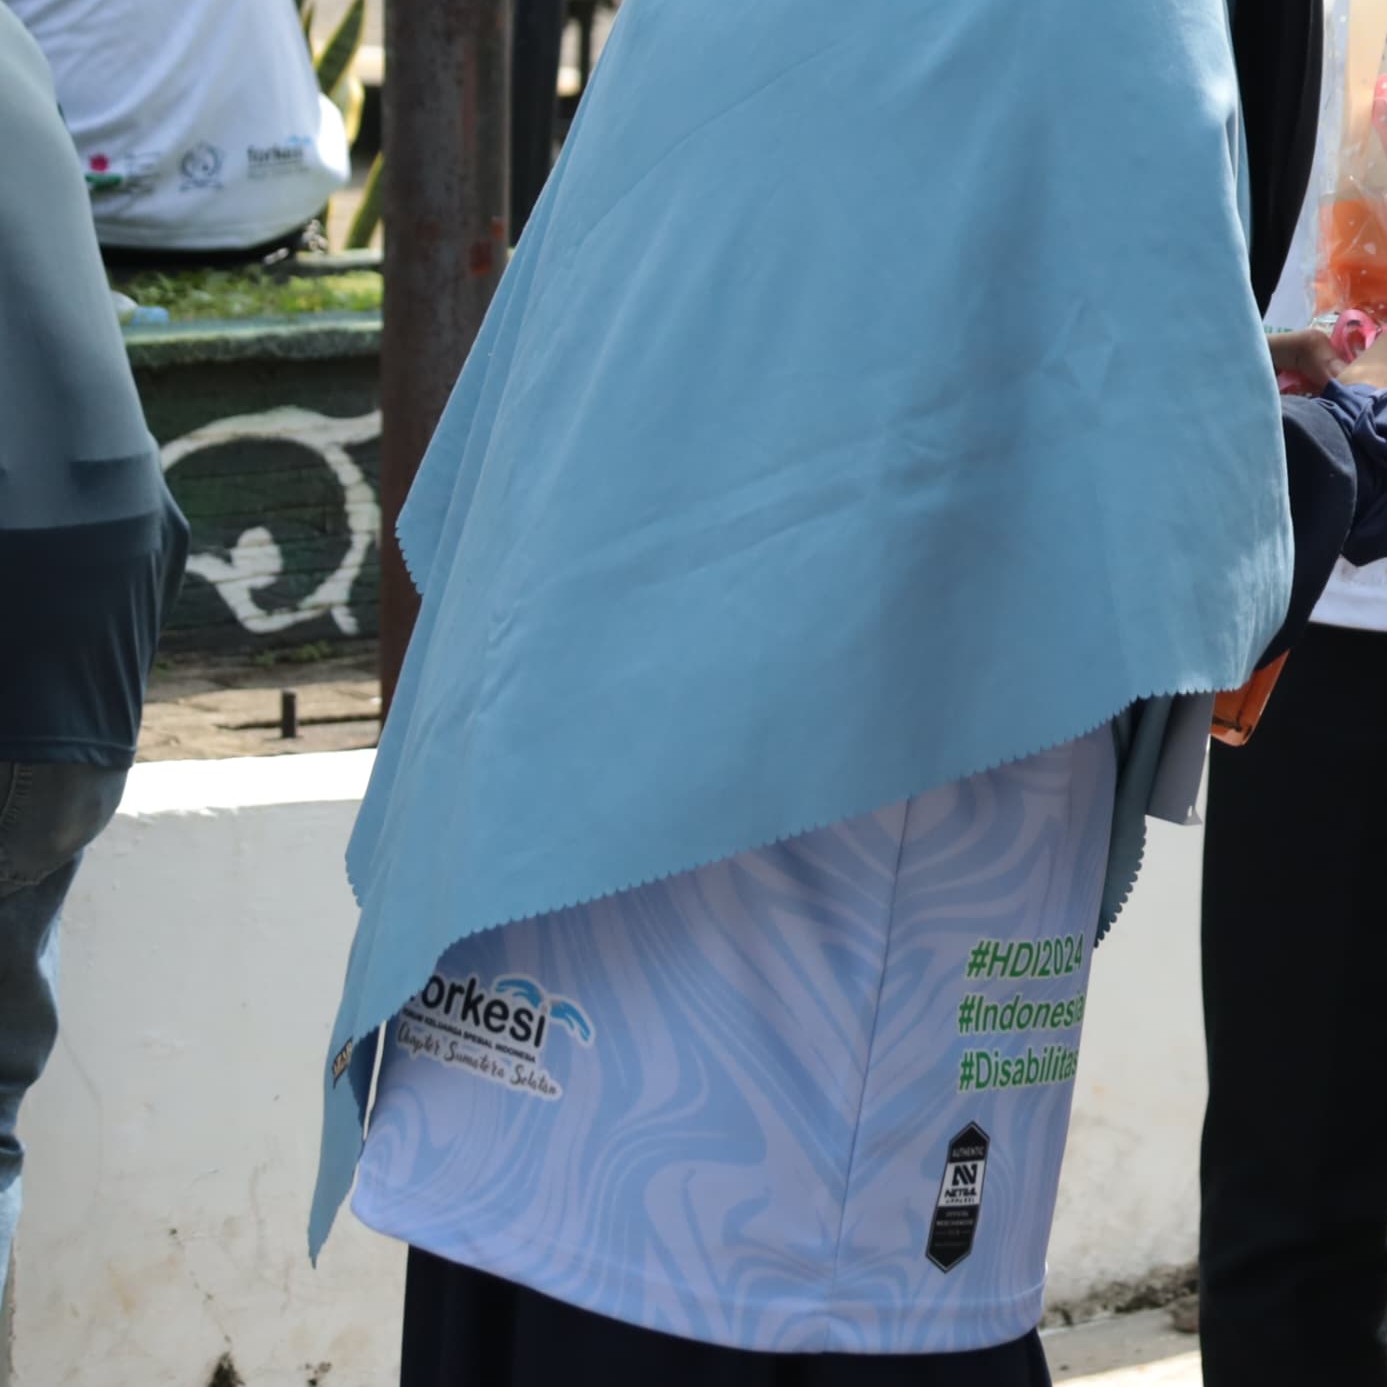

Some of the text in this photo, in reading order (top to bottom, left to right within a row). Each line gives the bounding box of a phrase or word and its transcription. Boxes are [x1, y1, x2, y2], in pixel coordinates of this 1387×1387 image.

[966, 933, 1084, 978] #HDI2024
[410, 974, 549, 1049] orkesi
[958, 990, 1085, 1034] #Indonesia
[443, 1040, 505, 1080] Sumatera
[509, 1063, 558, 1097] Selatan
[958, 1045, 1080, 1091] #Disabilitas
